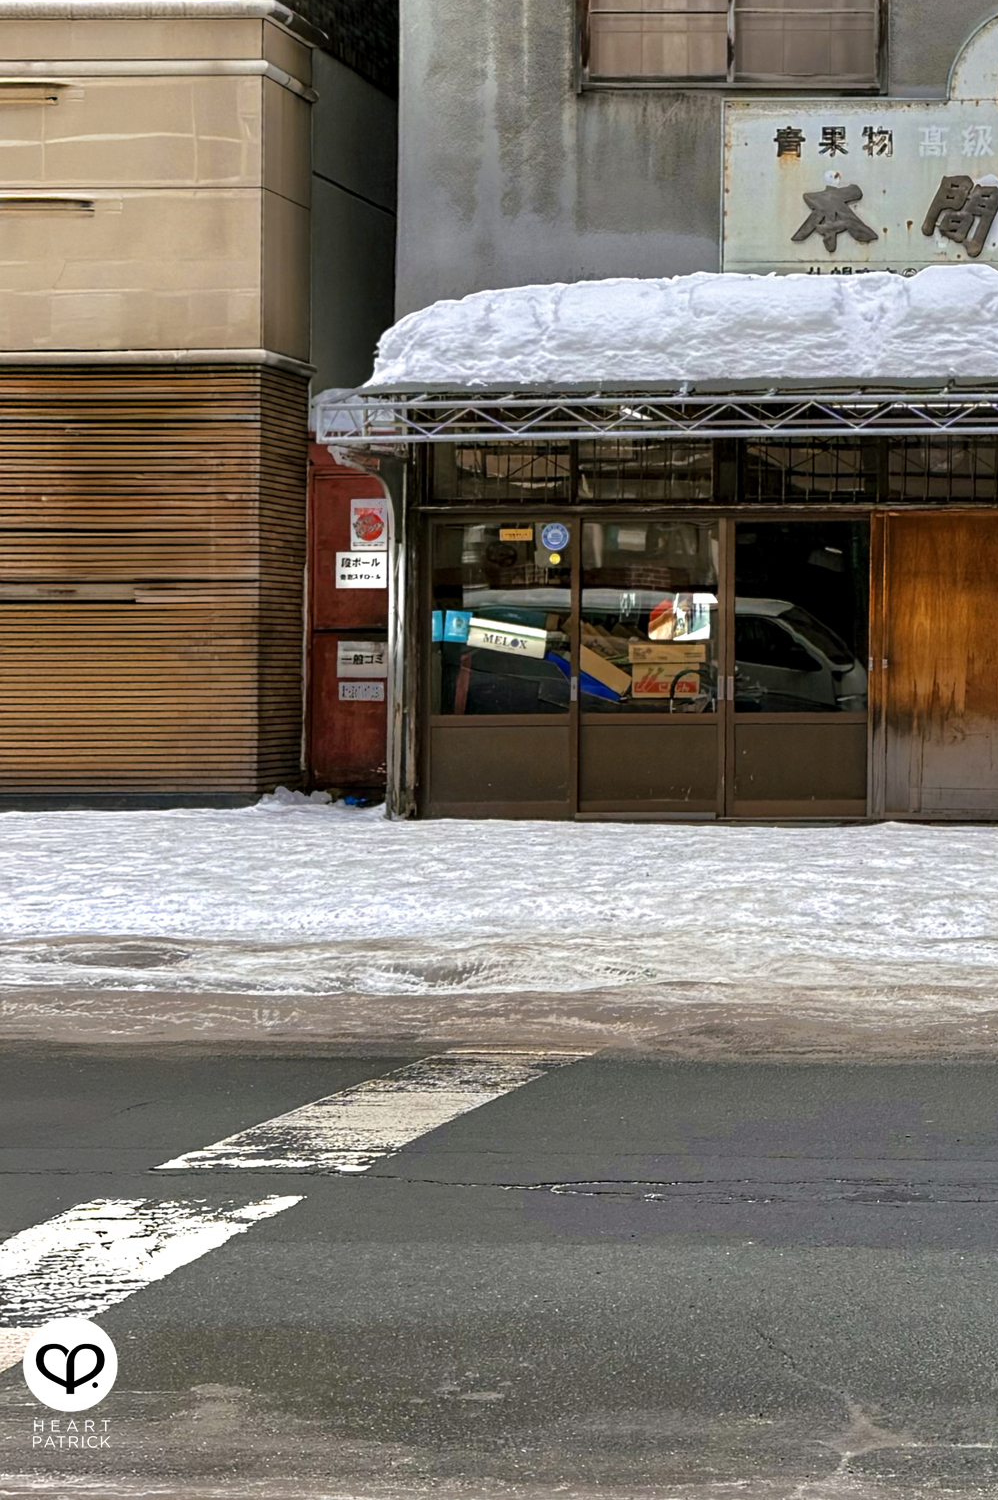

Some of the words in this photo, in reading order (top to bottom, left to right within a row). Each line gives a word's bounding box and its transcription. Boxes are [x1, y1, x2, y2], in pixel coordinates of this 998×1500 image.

[773, 125, 894, 157] 青果物
[341, 557, 381, 568] 段ボール
